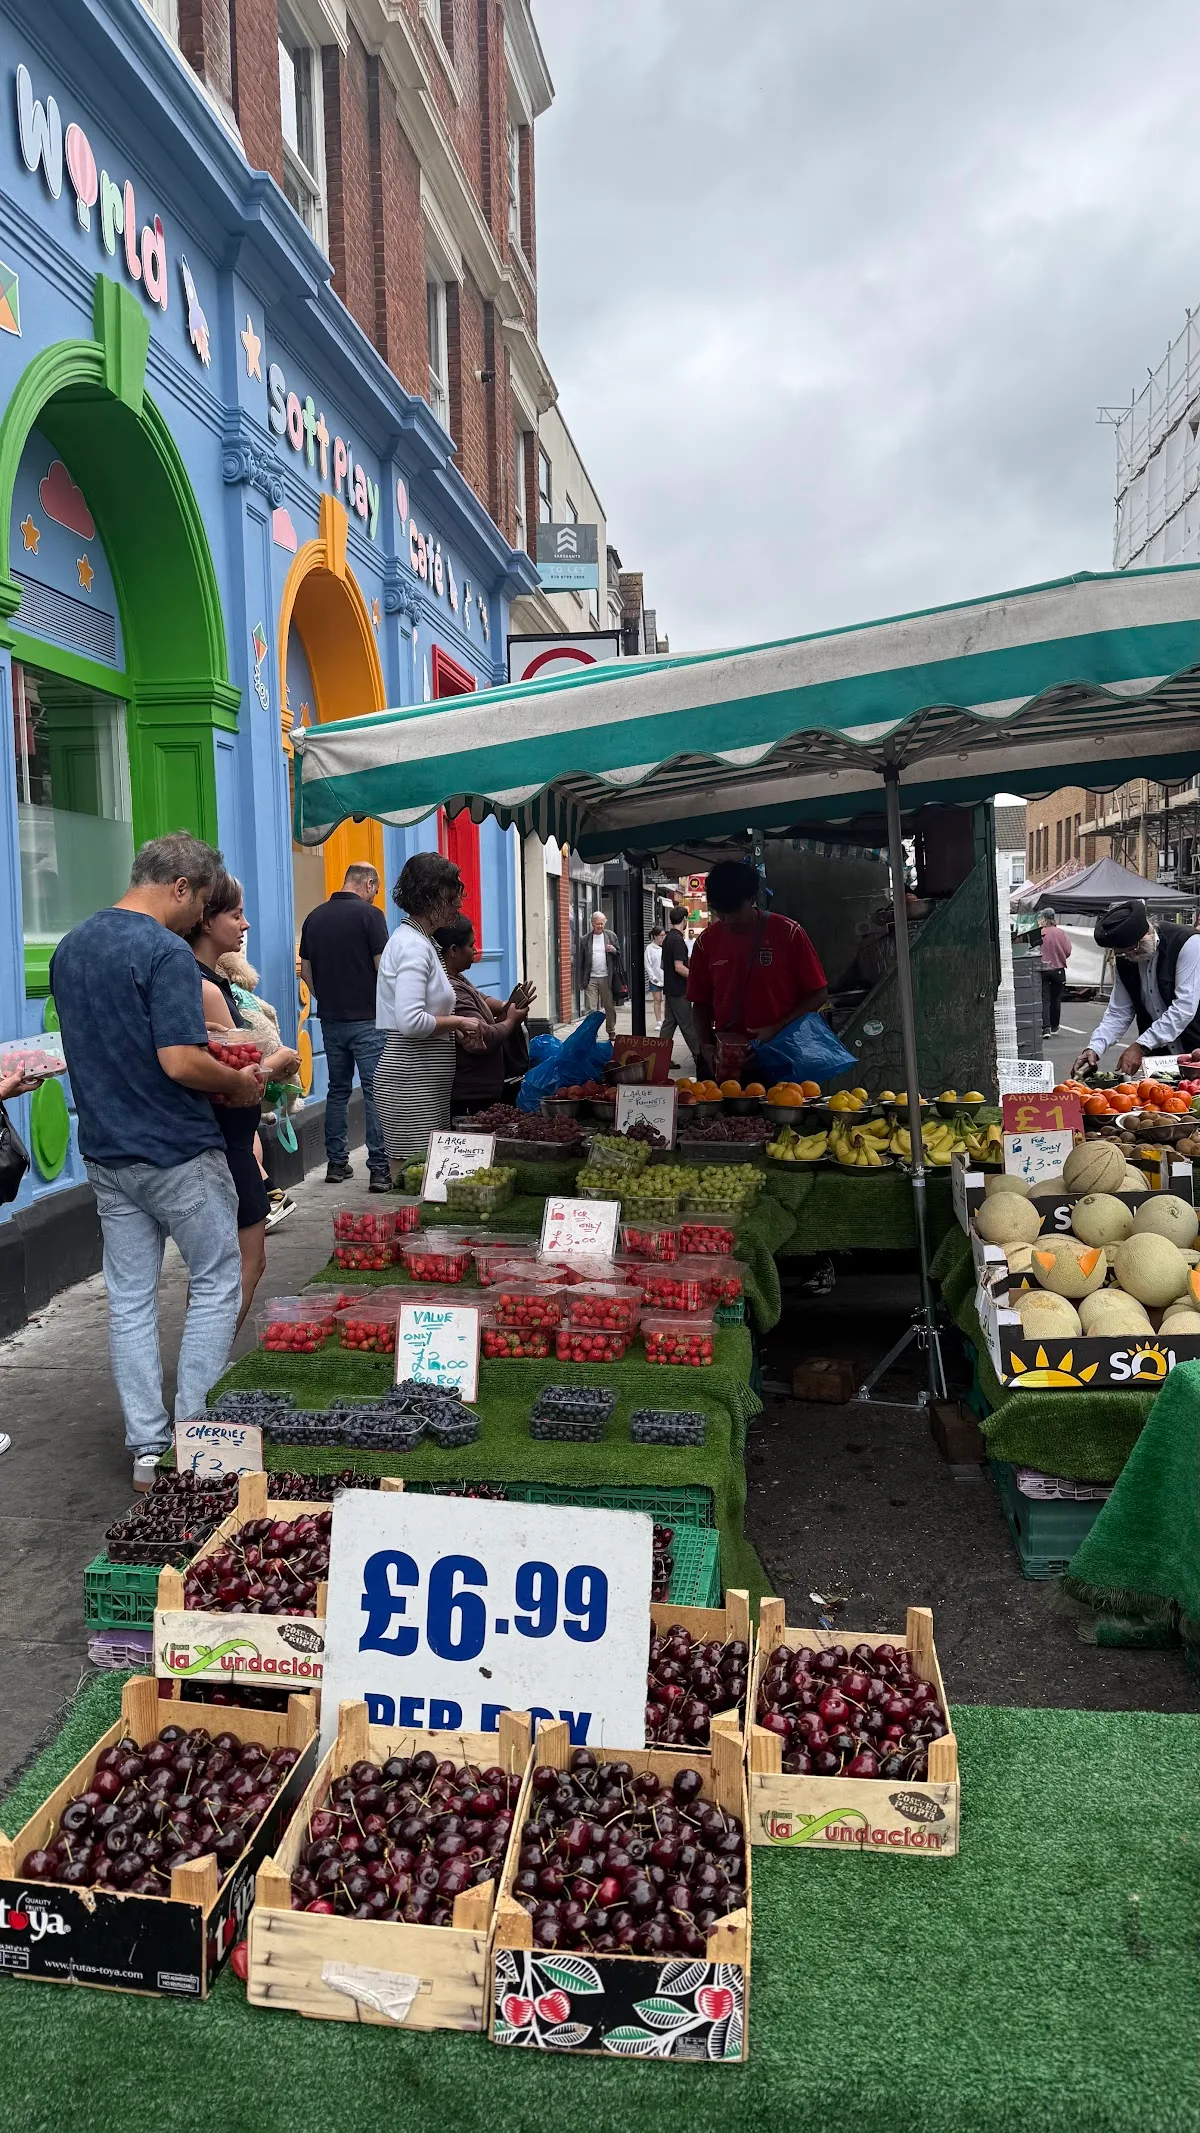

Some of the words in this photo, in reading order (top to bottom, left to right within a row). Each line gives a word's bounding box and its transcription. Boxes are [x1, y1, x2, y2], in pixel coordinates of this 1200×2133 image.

[269, 363, 329, 480] Soft
[568, 566, 586, 574] LET
[619, 1036, 639, 1046] Any
[643, 1038, 669, 1047] Bowl
[623, 1090, 653, 1098] LARGE
[1008, 1094, 1035, 1103] Any
[1014, 1105, 1065, 1131] £1
[437, 1136, 467, 1145] LARGE
[1040, 1142, 1061, 1152] ONLY
[579, 1221, 602, 1233] ONLY
[548, 1230, 597, 1249] £3.00
[413, 1310, 453, 1324] VALUE
[403, 1331, 433, 1345] ONLY
[411, 1348, 469, 1372] £2.00
[436, 1374, 462, 1386] BOX
[185, 1425, 247, 1440] CHERRIES
[358, 1549, 608, 1661] £6.99
[169, 1651, 190, 1669] la
[896, 1791, 938, 1814] COSECHA
[893, 1800, 936, 1821] PROPIA
[770, 1818, 792, 1837] la
[25, 1897, 51, 1906] QUALITY
